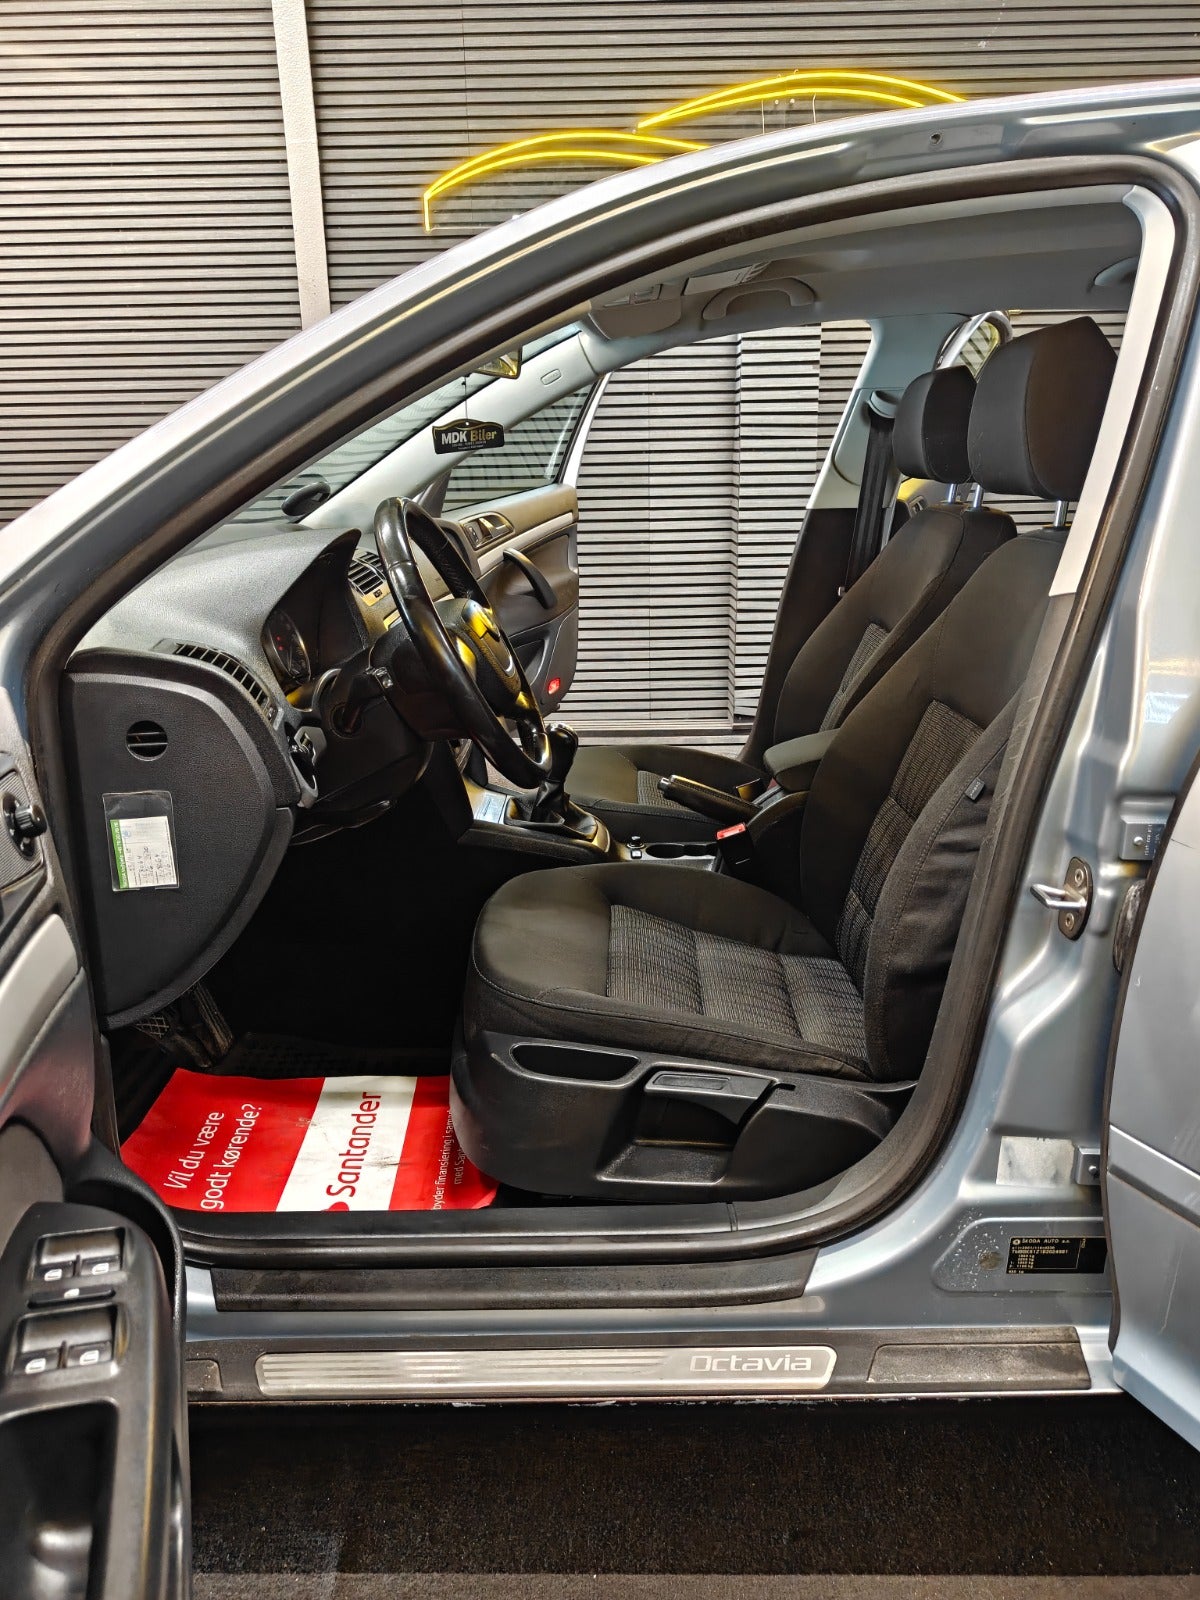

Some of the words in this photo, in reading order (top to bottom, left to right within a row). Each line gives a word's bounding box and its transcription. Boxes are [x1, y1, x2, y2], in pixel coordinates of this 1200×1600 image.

[441, 431, 467, 445] MDK
[470, 428, 497, 441] Biler
[193, 1111, 225, 1147] være
[213, 1103, 262, 1168] kørende?
[325, 1091, 382, 1198] Santander
[178, 1150, 206, 1169] du
[434, 1139, 454, 1185] finansiering
[163, 1170, 195, 1189] Vil
[454, 1167, 464, 1185] med
[200, 1171, 232, 1210] godt
[690, 1354, 812, 1372] Octavia
